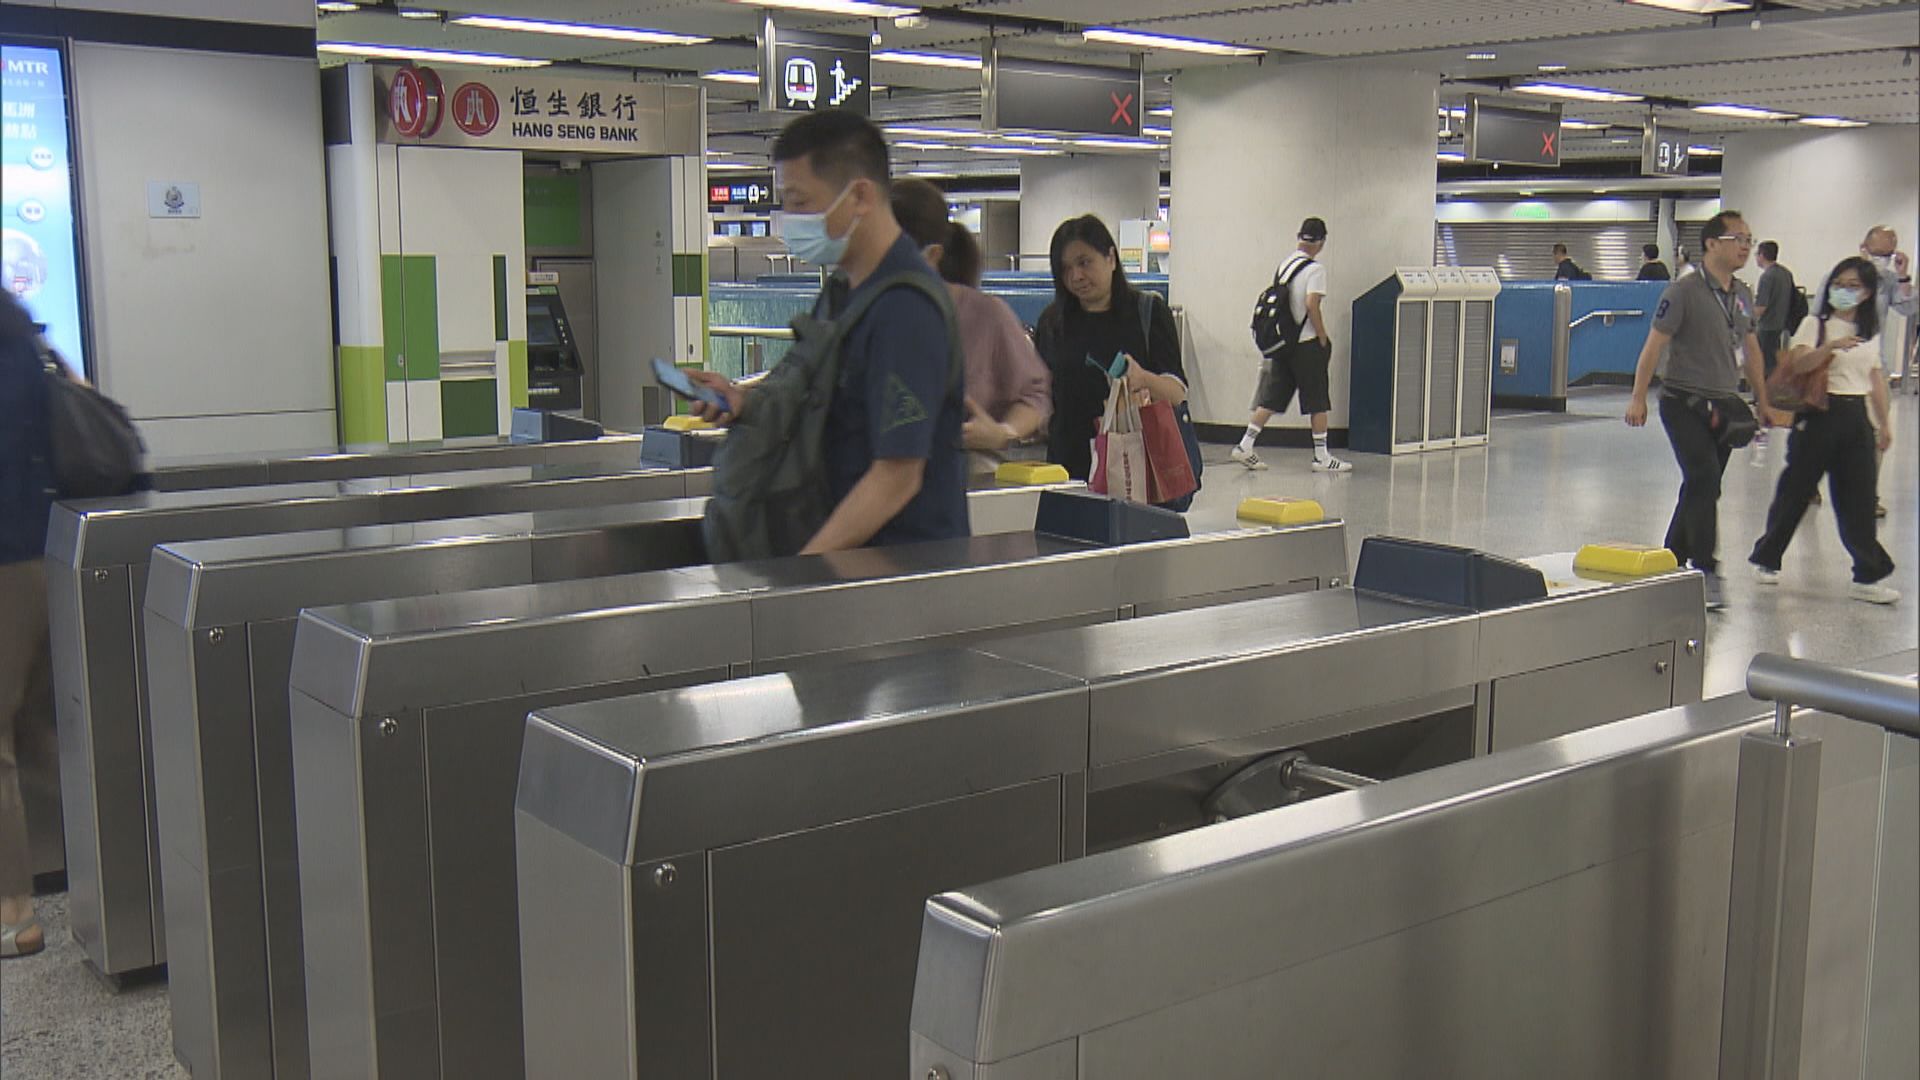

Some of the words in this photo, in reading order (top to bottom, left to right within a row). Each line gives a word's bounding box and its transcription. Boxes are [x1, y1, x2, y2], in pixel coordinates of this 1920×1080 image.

[7, 59, 49, 75] MTR
[510, 86, 637, 121] 恒生銀行
[512, 122, 553, 138] HANG
[557, 124, 595, 140] SENG
[600, 126, 638, 142] BANK
